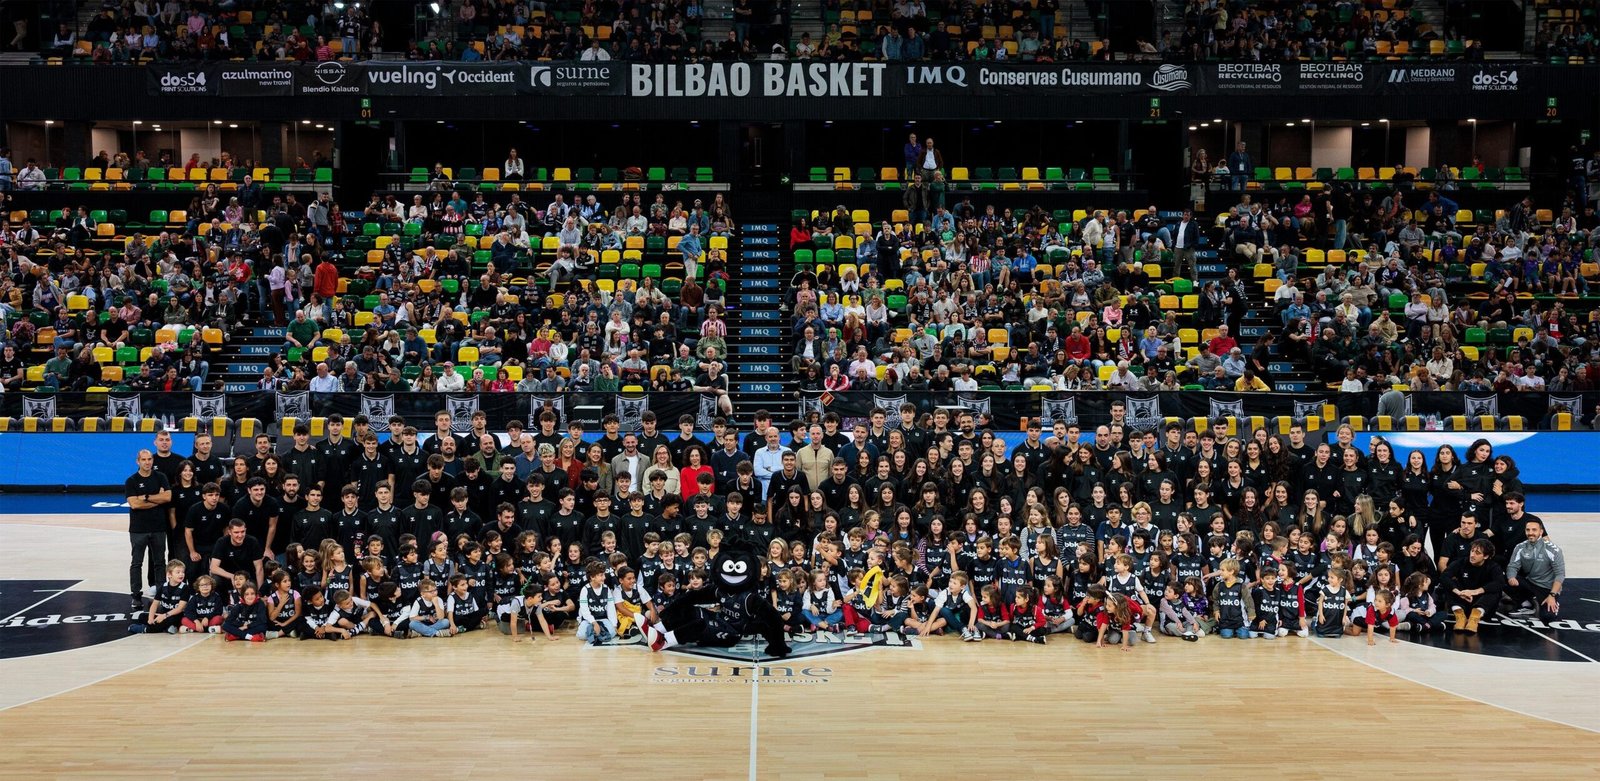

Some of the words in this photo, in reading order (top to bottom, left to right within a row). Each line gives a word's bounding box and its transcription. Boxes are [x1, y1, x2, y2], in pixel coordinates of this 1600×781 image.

[556, 66, 610, 80] surne
[1218, 63, 1281, 73] BEOTIBAR
[1300, 63, 1363, 73] BEOTIBAR
[1410, 69, 1455, 77] MEDRANO
[160, 71, 206, 87] dos54
[222, 69, 292, 80] azulmarino
[368, 65, 441, 90] vueling
[458, 70, 515, 83] Occident
[631, 62, 751, 97] BILBAO
[763, 62, 887, 97] BASKET
[907, 65, 968, 87] IMQ
[979, 68, 1057, 86] Conservas
[1062, 68, 1141, 86] Cusumano
[1153, 69, 1188, 86] Cusumano
[1472, 70, 1518, 85] dos54
[361, 109, 372, 118] 01
[1150, 108, 1161, 117] 21
[1547, 108, 1557, 117] 20
[264, 329, 282, 337] IMQ
[749, 346, 768, 354] IMQ
[750, 384, 771, 392] IMQ
[401, 581, 417, 589] bbk
[653, 666, 833, 677] surne
